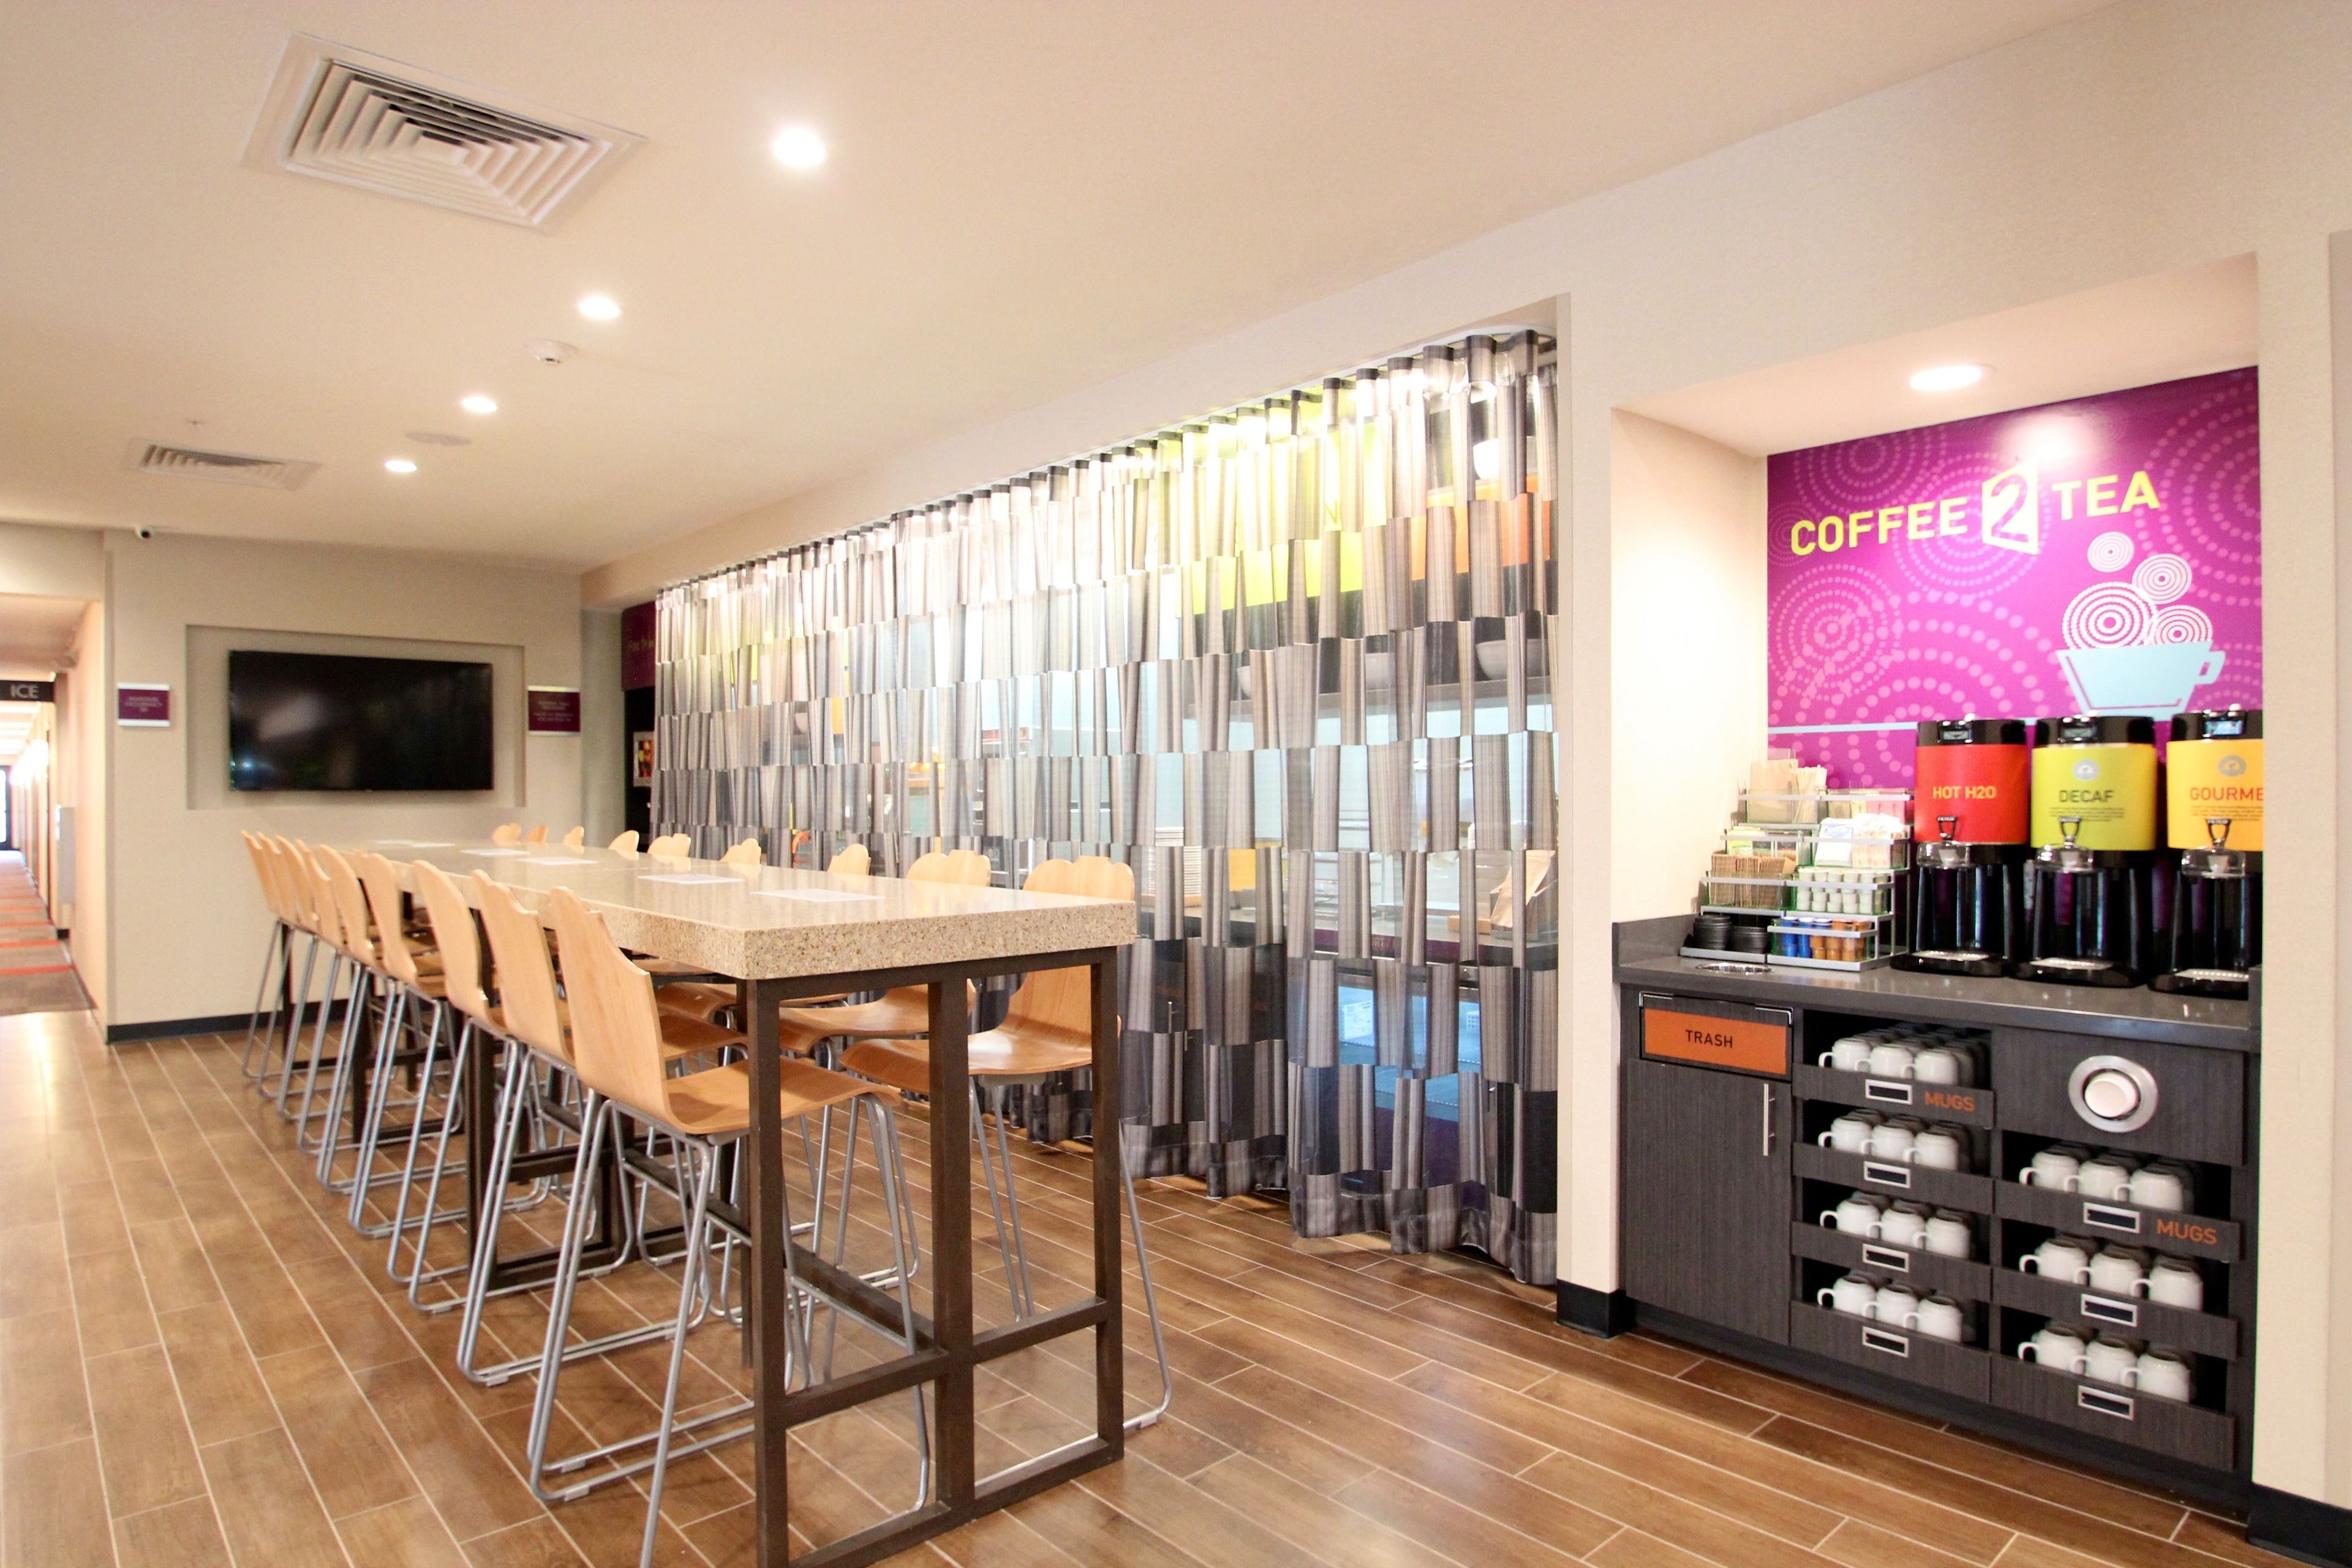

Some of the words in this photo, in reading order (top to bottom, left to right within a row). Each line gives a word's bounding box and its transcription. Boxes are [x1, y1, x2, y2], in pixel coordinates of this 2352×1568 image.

[1791, 496, 1968, 556] COFFEE
[1991, 474, 2028, 543] 2
[2052, 470, 2160, 521] TEA
[10, 684, 39, 698] ICE
[1932, 786, 1960, 799] HOT
[2059, 790, 2114, 803] DECAF
[2190, 787, 2264, 801] GOURME
[1685, 1030, 1733, 1048] TRASH
[1924, 1091, 1975, 1112] MUGS
[2157, 1218, 2217, 1245] MUGS
